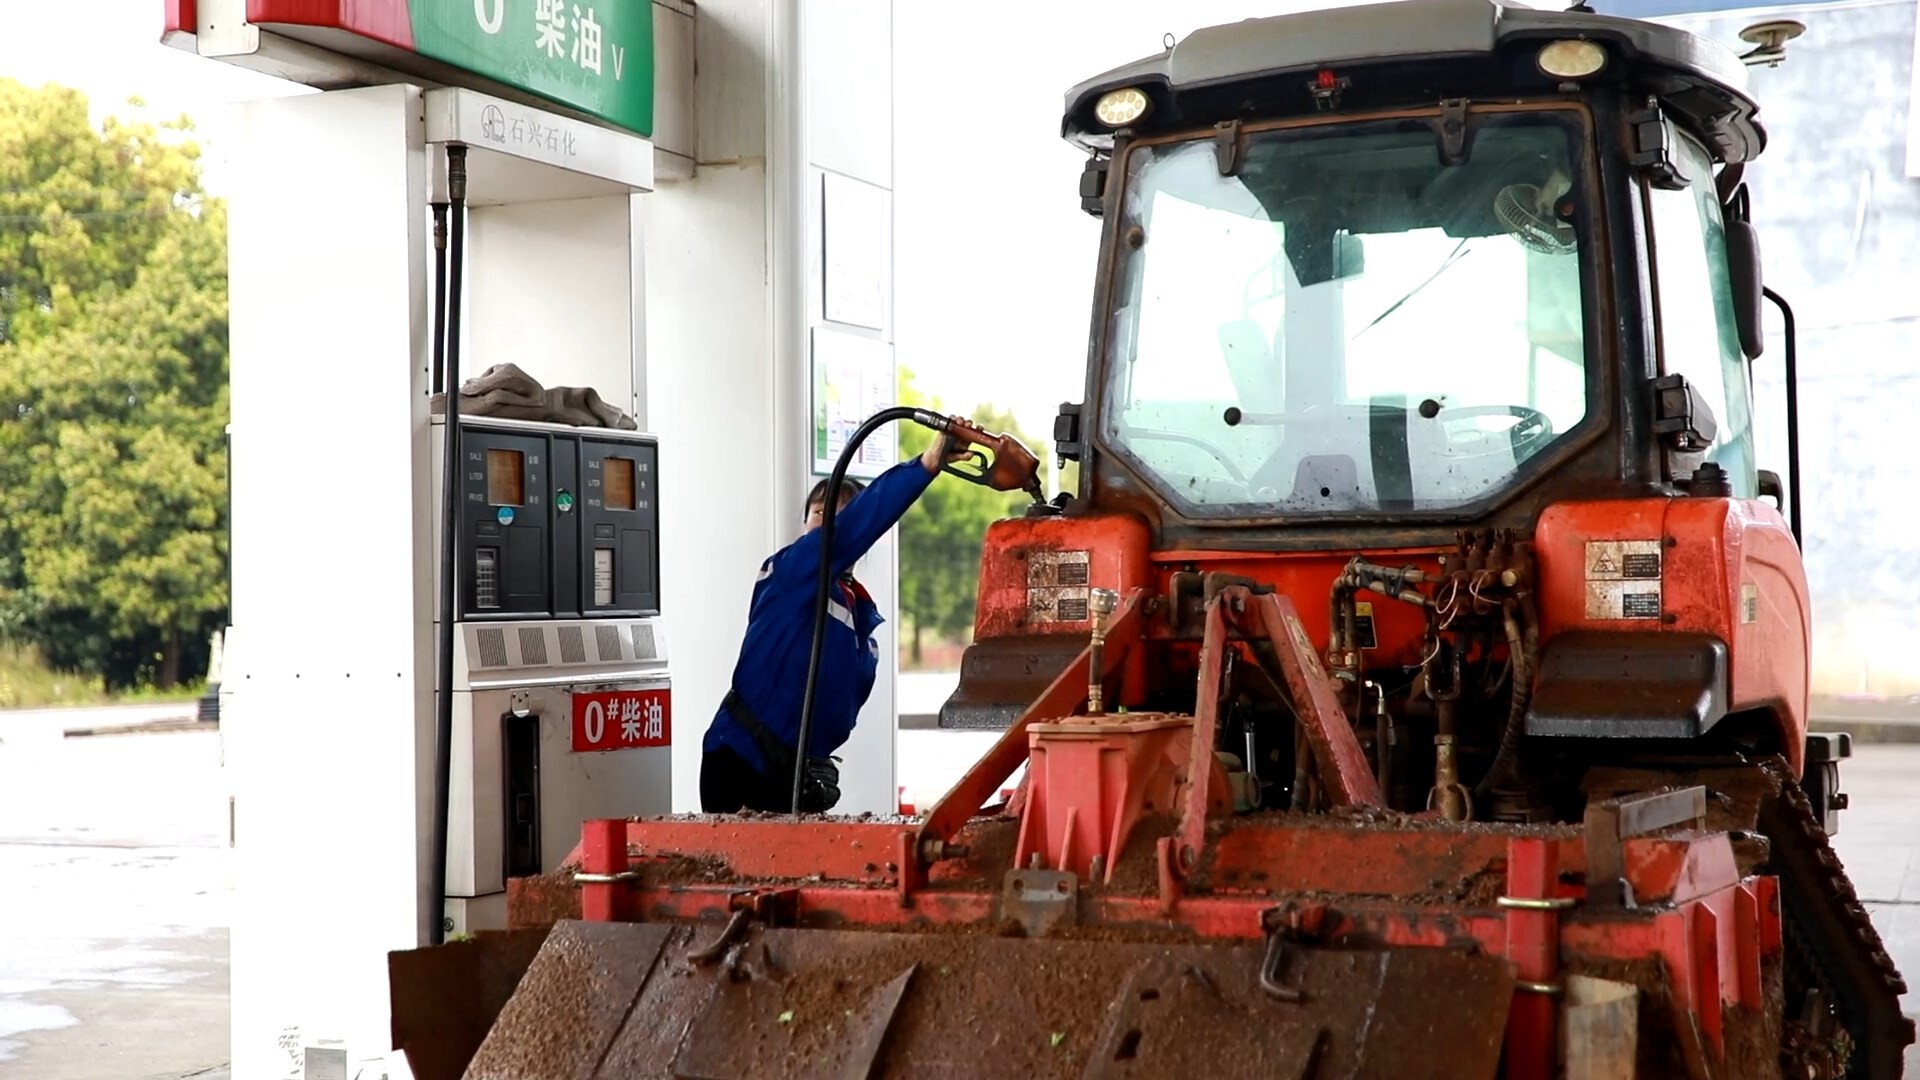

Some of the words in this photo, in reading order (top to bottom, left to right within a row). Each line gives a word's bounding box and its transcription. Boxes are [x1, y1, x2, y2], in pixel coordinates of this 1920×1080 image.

[534, 0, 602, 76] 柴油
[611, 43, 624, 81] V
[509, 116, 577, 157] 石兴石化
[584, 696, 662, 744] 0#柴油
